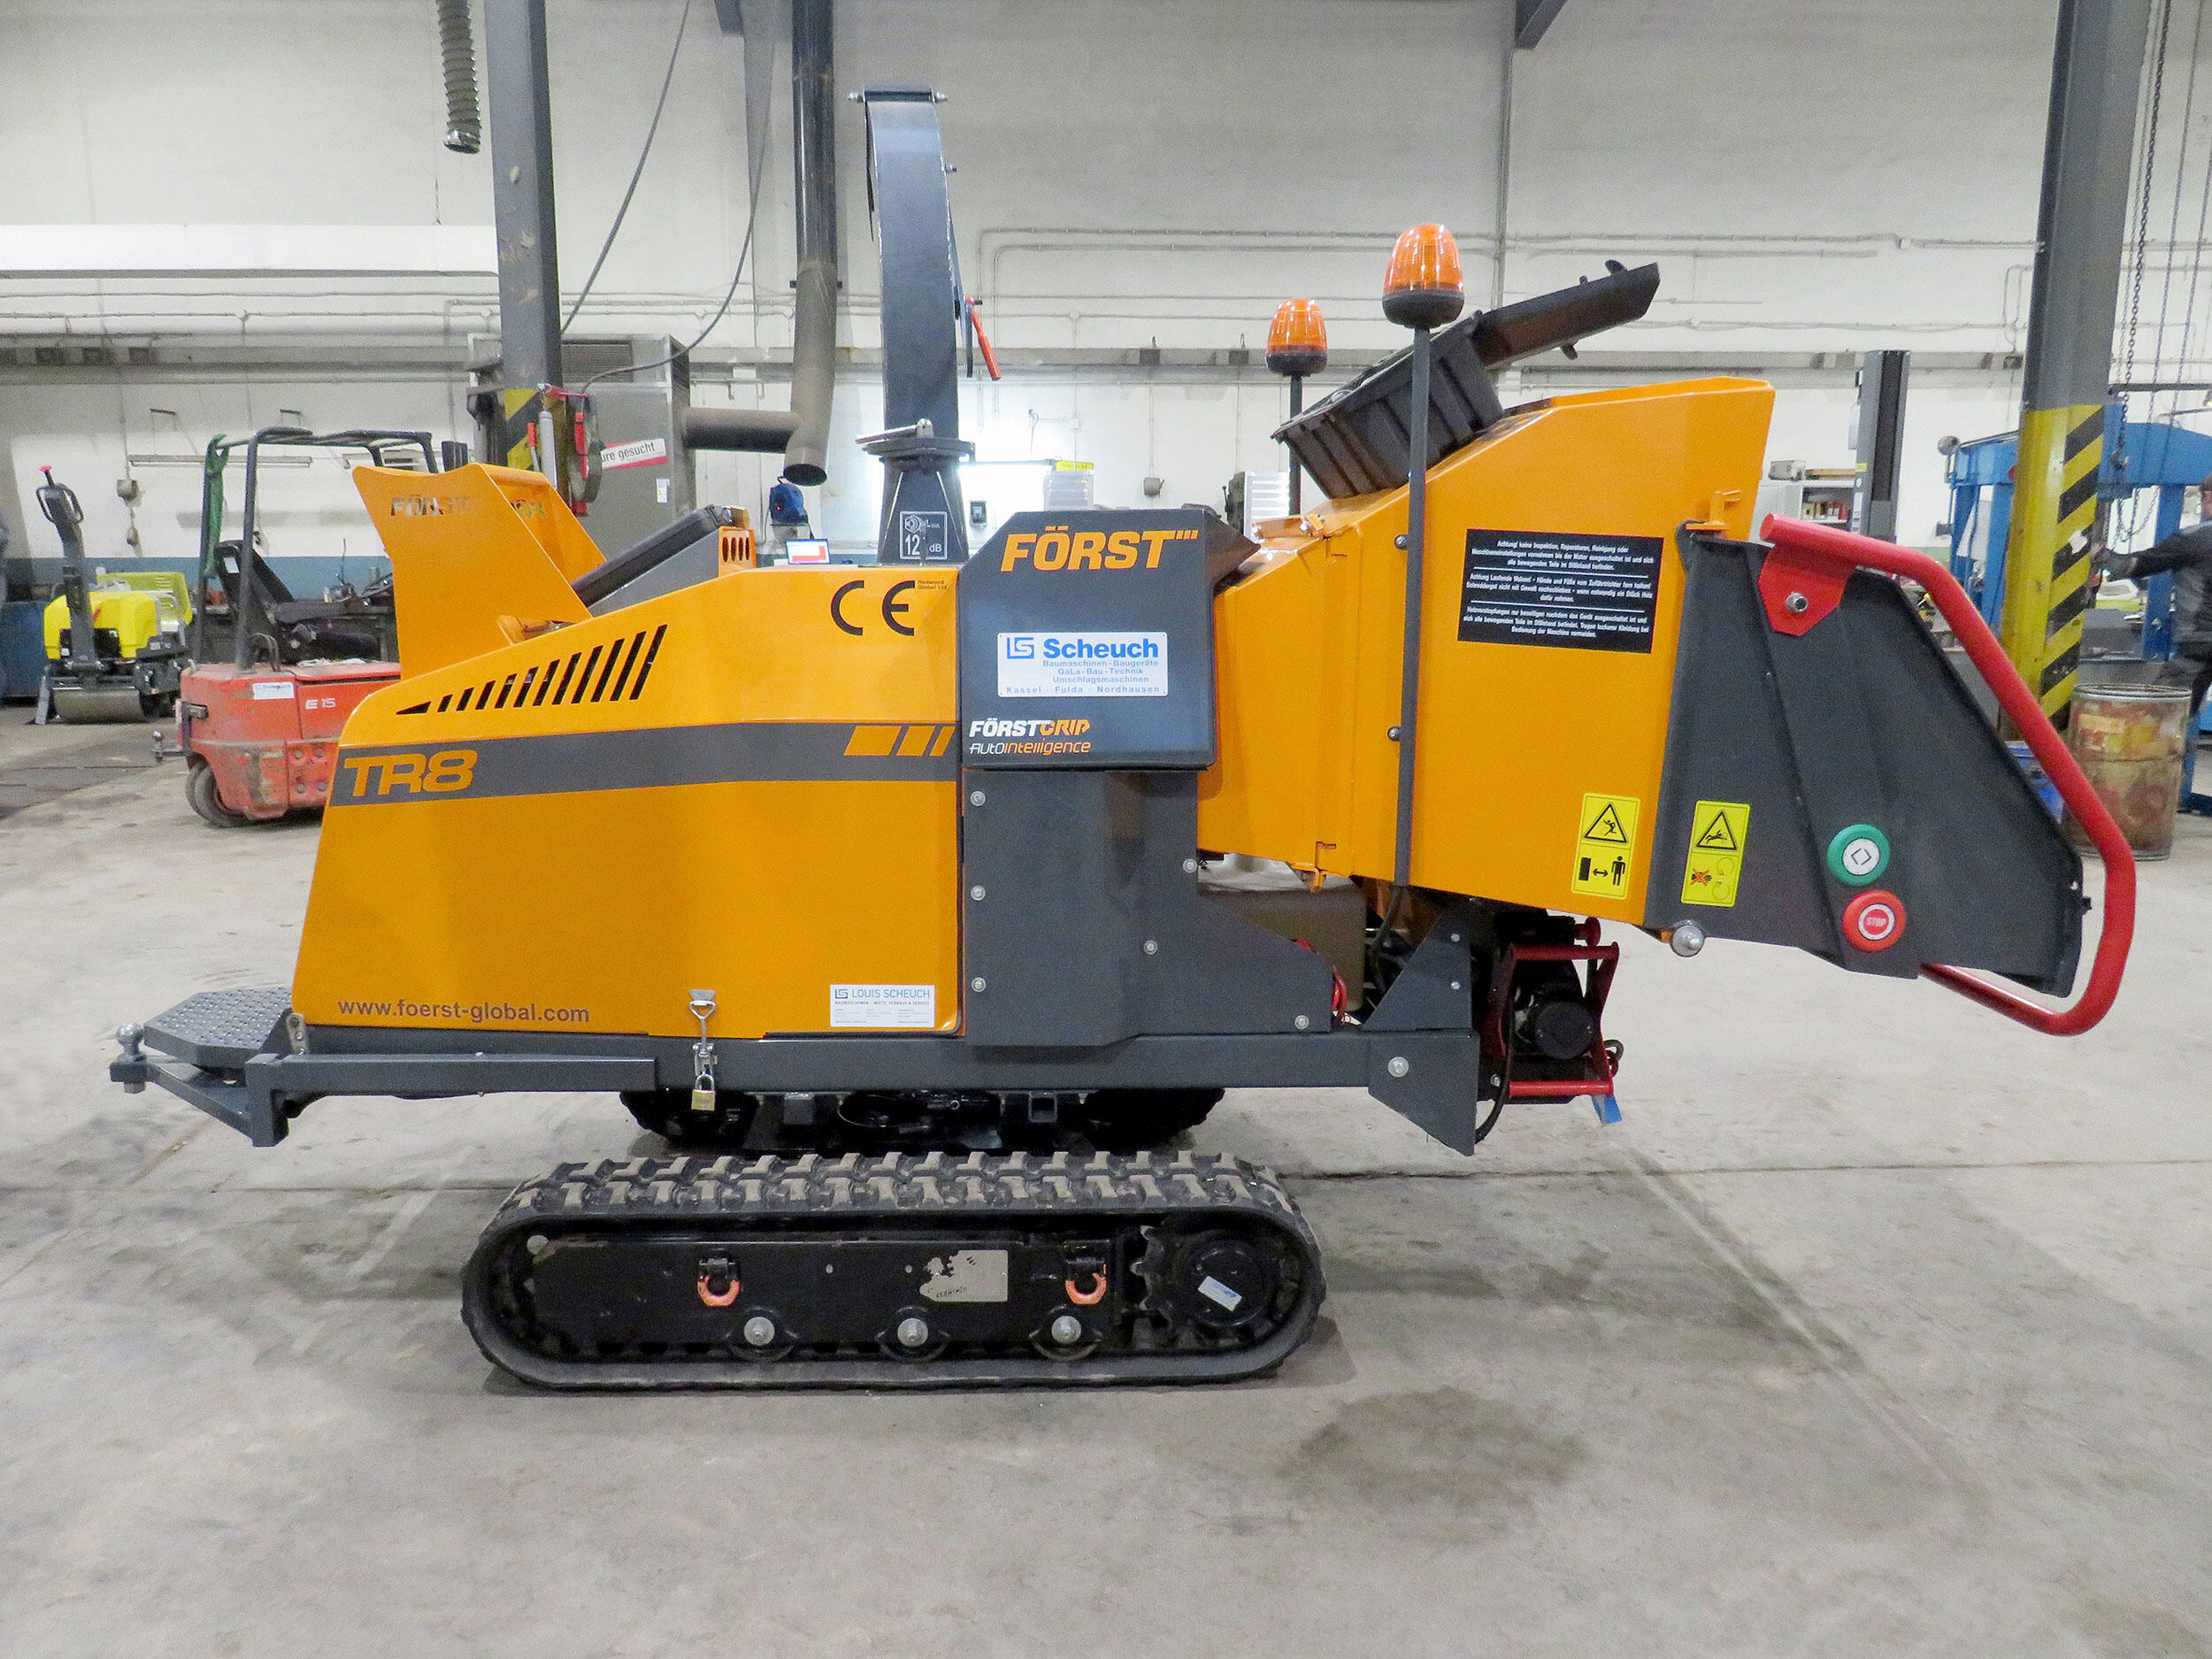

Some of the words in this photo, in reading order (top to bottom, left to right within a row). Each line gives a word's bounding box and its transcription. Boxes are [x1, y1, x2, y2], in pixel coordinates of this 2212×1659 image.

[618, 442, 656, 460] gesucht
[928, 543, 942, 553] dB
[1001, 525, 1200, 572] FÖRST
[831, 580, 915, 636] CE
[1043, 638, 1158, 659] Scheuch
[343, 749, 479, 797] TR8
[1867, 917, 1886, 927] STOP
[851, 988, 881, 998] LOUIS
[883, 989, 930, 999] SCHEUCH
[338, 999, 590, 1023] www.foerst-global.com
